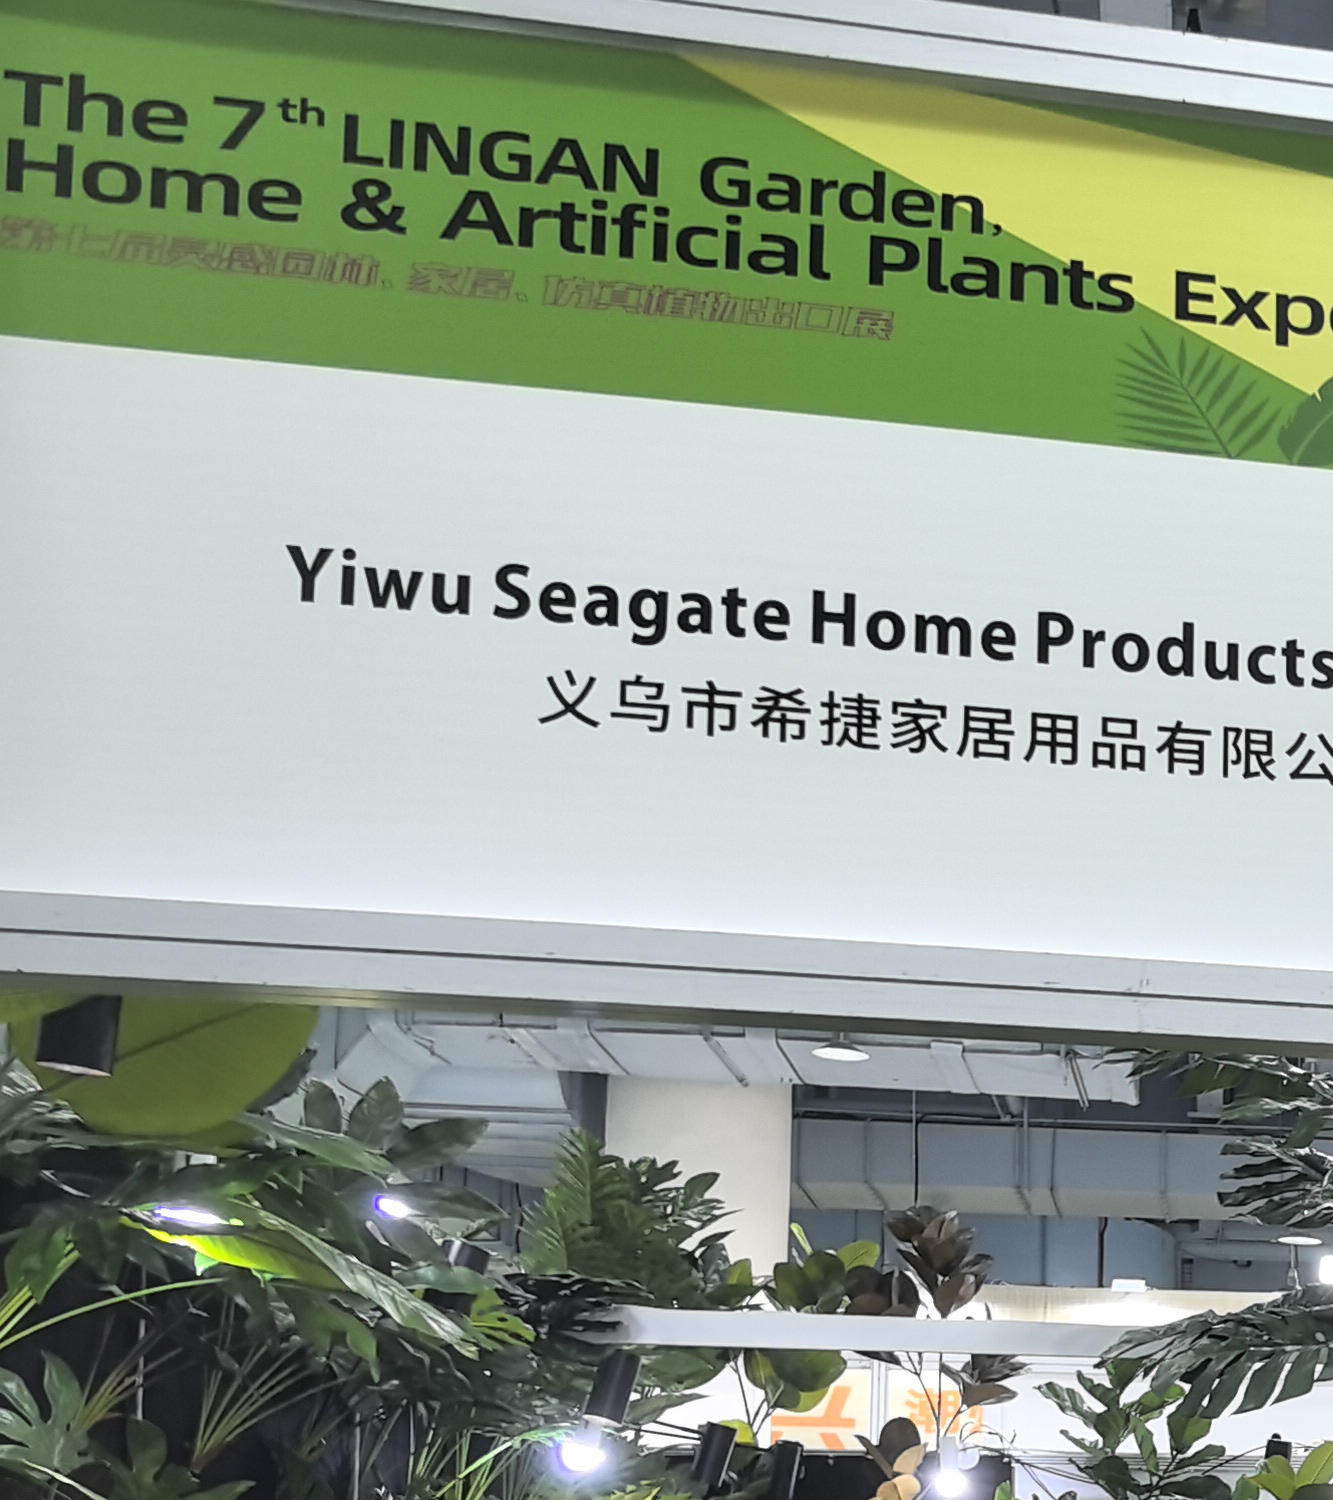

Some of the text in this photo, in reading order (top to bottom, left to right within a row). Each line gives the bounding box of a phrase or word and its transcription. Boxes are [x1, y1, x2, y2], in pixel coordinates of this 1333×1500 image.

[4, 69, 1002, 238] The 7th LINGAN Garden,
[5, 137, 302, 222] Home
[340, 177, 407, 235] &
[439, 189, 832, 281] Artificial
[868, 234, 1135, 313] Plants
[285, 544, 471, 616] Yiwu
[492, 563, 791, 647] Seagate
[810, 589, 1017, 662] Home
